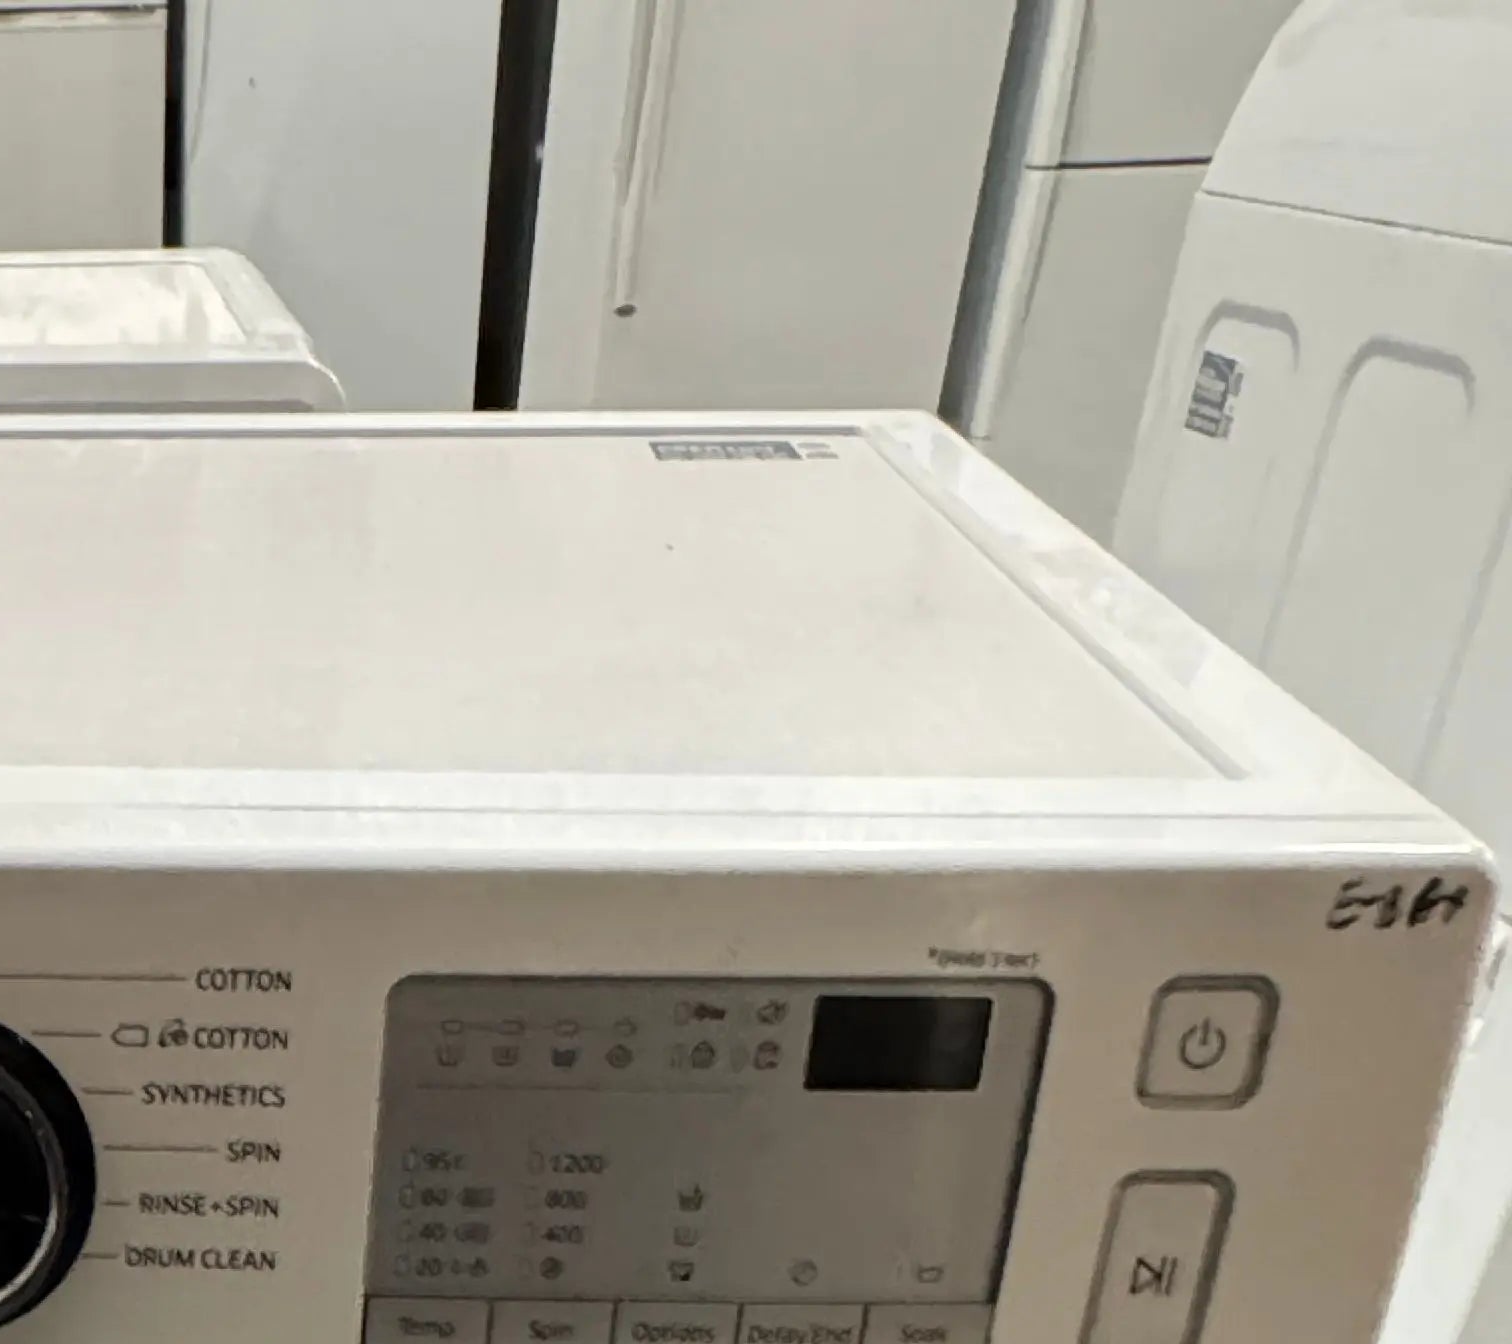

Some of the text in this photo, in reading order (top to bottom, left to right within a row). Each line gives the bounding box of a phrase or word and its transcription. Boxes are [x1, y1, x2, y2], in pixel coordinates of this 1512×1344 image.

[195, 969, 293, 992] COTTON
[194, 1028, 289, 1052] COTTON
[140, 1083, 287, 1108] SYNTHETICS
[227, 1141, 281, 1164] SPIN
[548, 1154, 605, 1174] 1200
[124, 1246, 278, 1271] DRUM CLEAN
[398, 1315, 456, 1339] Temp
[527, 1318, 574, 1342] Spin
[811, 1323, 854, 1344] End
